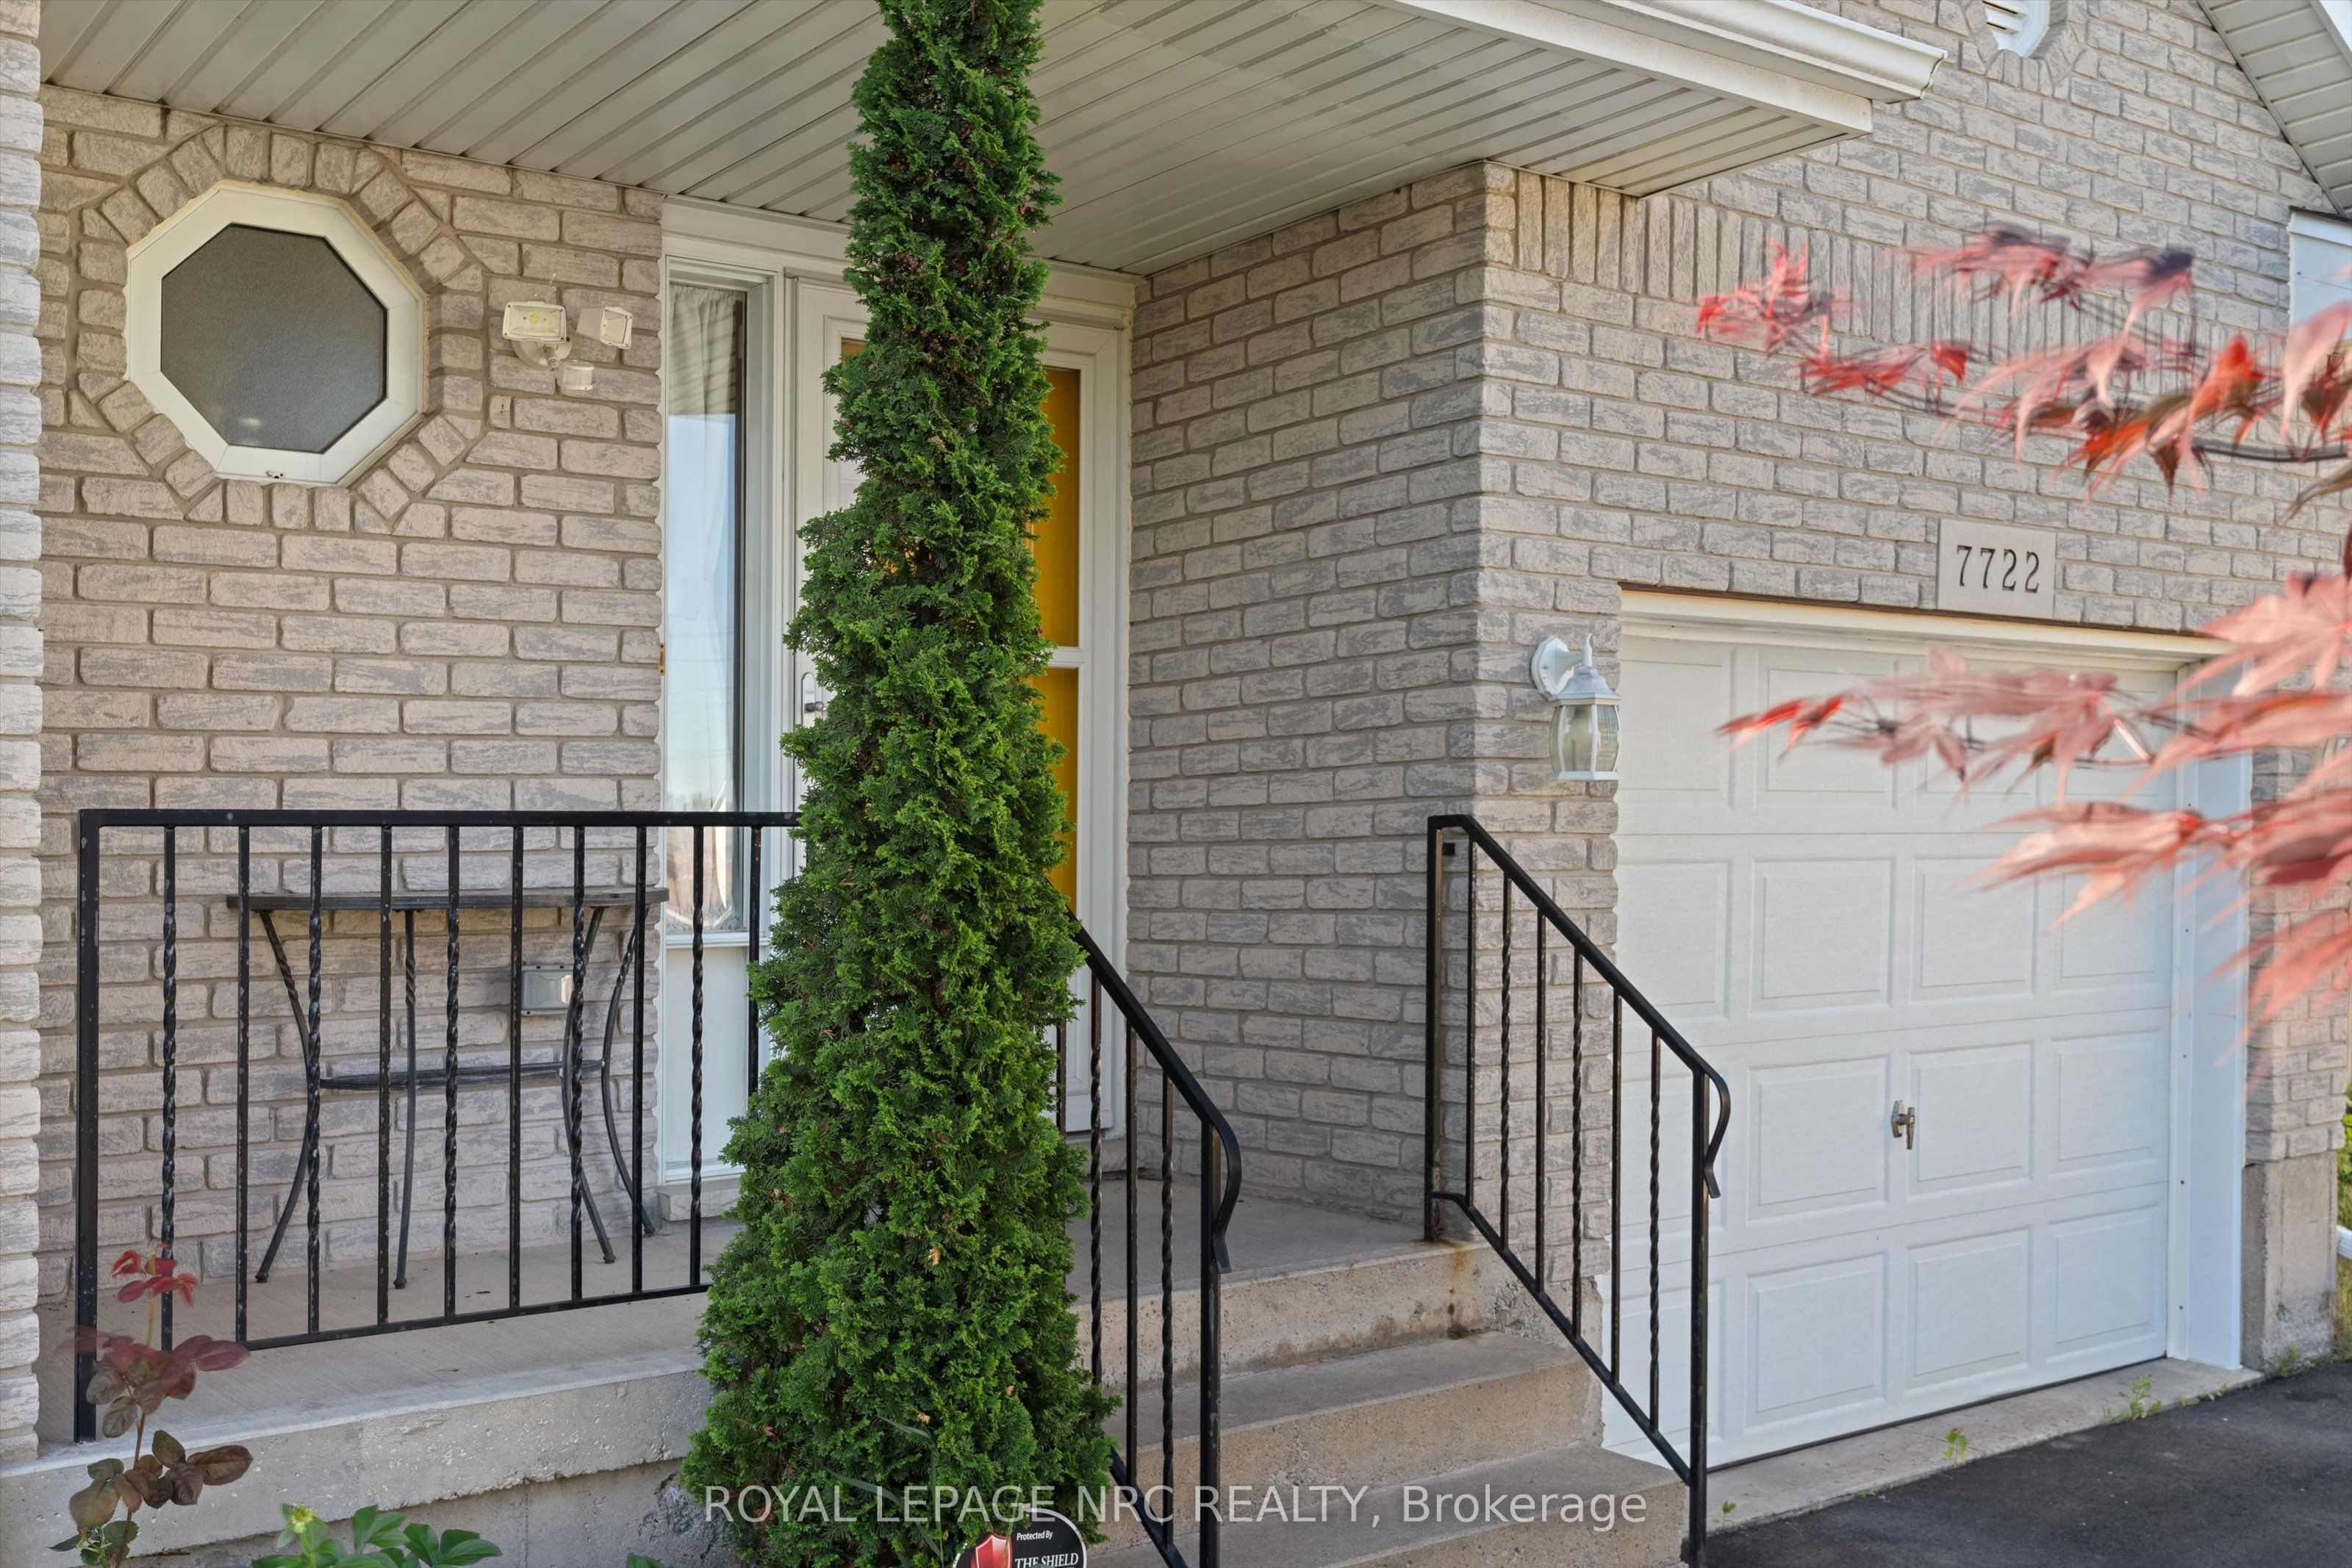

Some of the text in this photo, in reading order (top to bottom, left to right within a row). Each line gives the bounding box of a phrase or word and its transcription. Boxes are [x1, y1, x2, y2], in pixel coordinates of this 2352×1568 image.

[1957, 544, 2040, 594] 7722
[1017, 1530, 1053, 1541] Protected By
[1041, 1553, 1079, 1567] SHIELD
